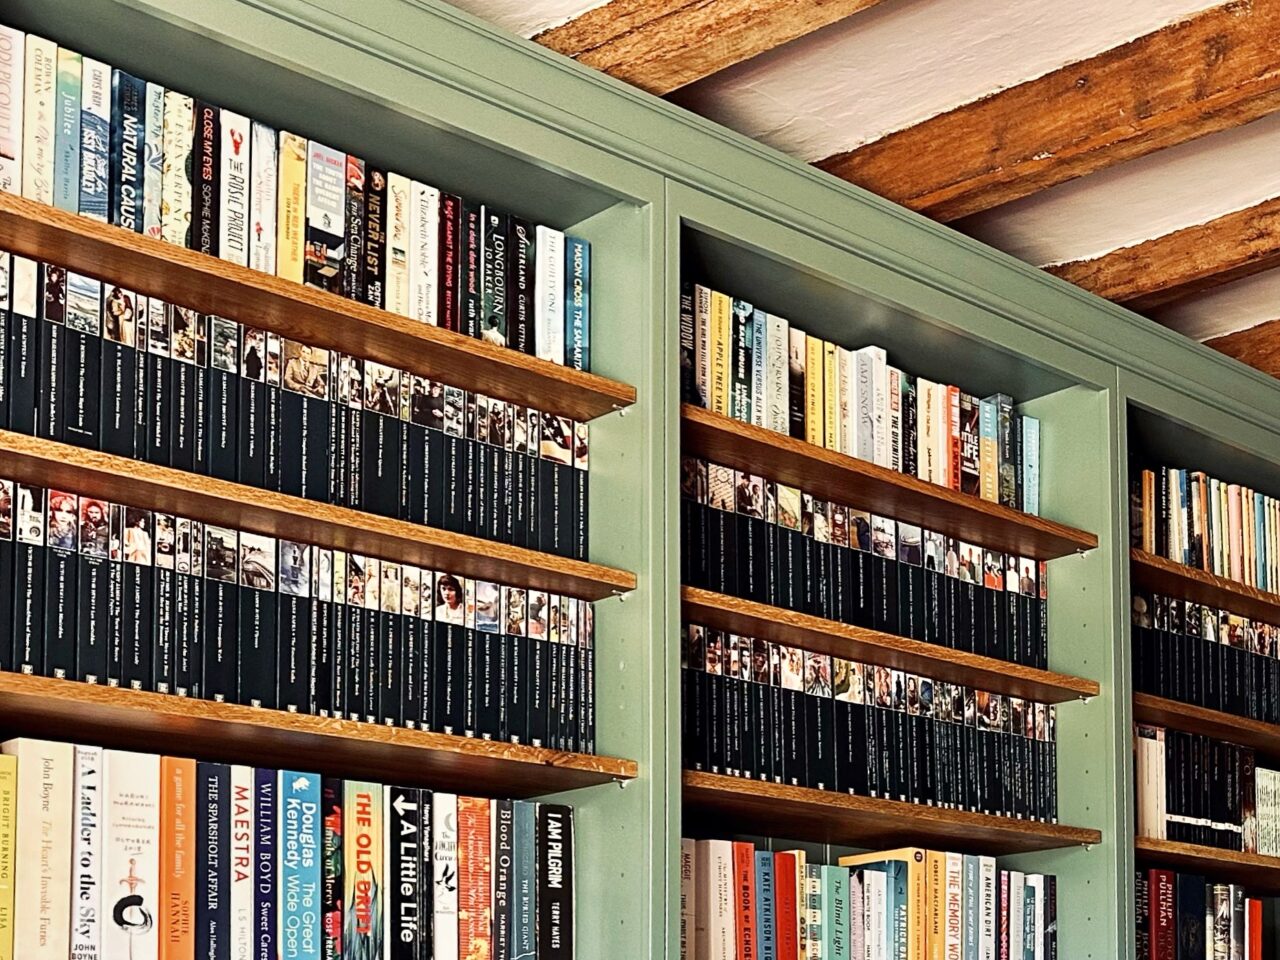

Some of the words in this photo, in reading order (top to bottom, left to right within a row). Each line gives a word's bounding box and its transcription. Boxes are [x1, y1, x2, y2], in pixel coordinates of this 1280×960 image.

[62, 92, 75, 135] Jubilee
[203, 108, 213, 138] CLOSE
[121, 114, 138, 182] NATURAL
[203, 141, 213, 156] MY
[203, 156, 213, 180] EYES
[228, 212, 243, 252] PROJECT
[369, 194, 380, 240] NEVER
[367, 243, 378, 274] LIST
[493, 234, 505, 315] LONGBOURN
[682, 295, 691, 310] THE
[681, 314, 693, 349] WIDOW
[82, 764, 95, 776] A
[208, 776, 218, 800] THE
[80, 785, 95, 845] Ladder
[260, 783, 271, 845] WILLIAM
[356, 793, 371, 826] THE
[401, 819, 416, 836] A
[207, 803, 218, 867] SPARSHOLT
[234, 785, 249, 882] MAESTRA
[286, 799, 301, 869] Kennedy
[301, 802, 316, 867] Douglas
[500, 810, 511, 849] Blood
[547, 819, 562, 840] AM
[81, 851, 96, 868] to
[260, 852, 271, 893] BOYD
[356, 834, 371, 874] OLD
[400, 842, 417, 895] Little
[547, 841, 562, 888] PILGRIM
[80, 874, 96, 900] the
[207, 870, 218, 910] AFFAIR
[287, 875, 300, 912] Wide
[303, 882, 315, 908] The
[496, 856, 510, 906] Orange
[949, 870, 959, 889] THE
[984, 876, 992, 917] AMERICAN
[75, 907, 95, 938] Sky
[260, 902, 270, 930] Sweet
[400, 903, 417, 943] Life
[552, 902, 560, 923] TERRY
[763, 897, 771, 942] ATKINSON
[834, 898, 842, 925] Blind
[948, 892, 960, 940] MEMORY
[286, 916, 299, 958] Open
[303, 912, 315, 953] Great
[552, 926, 560, 948] HAYES
[833, 930, 842, 956] Light
